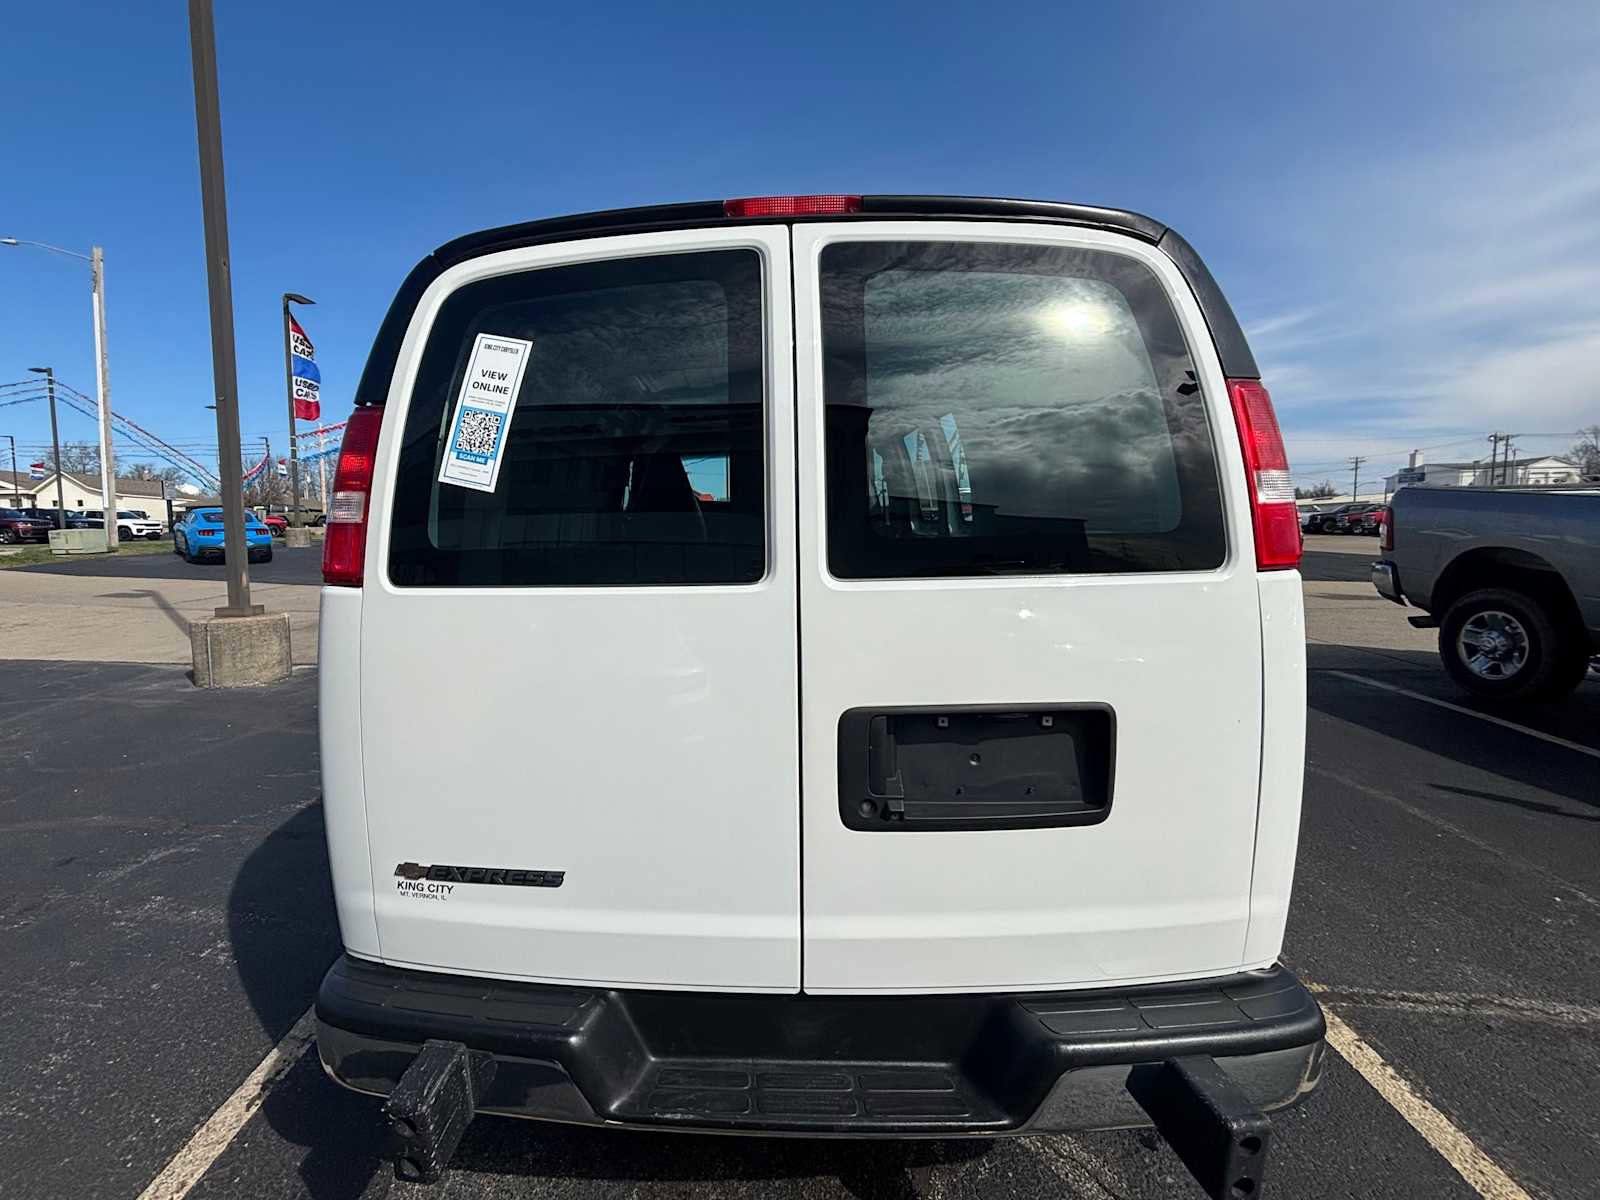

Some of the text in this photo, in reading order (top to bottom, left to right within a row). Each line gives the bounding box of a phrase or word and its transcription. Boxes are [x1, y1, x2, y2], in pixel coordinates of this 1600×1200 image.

[481, 369, 508, 381] VIEW
[295, 378, 319, 392] USED
[472, 381, 510, 395] ONLINE
[459, 453, 475, 462] SCAN
[429, 865, 565, 887] EXPRESS
[397, 880, 455, 894] KING CITY
